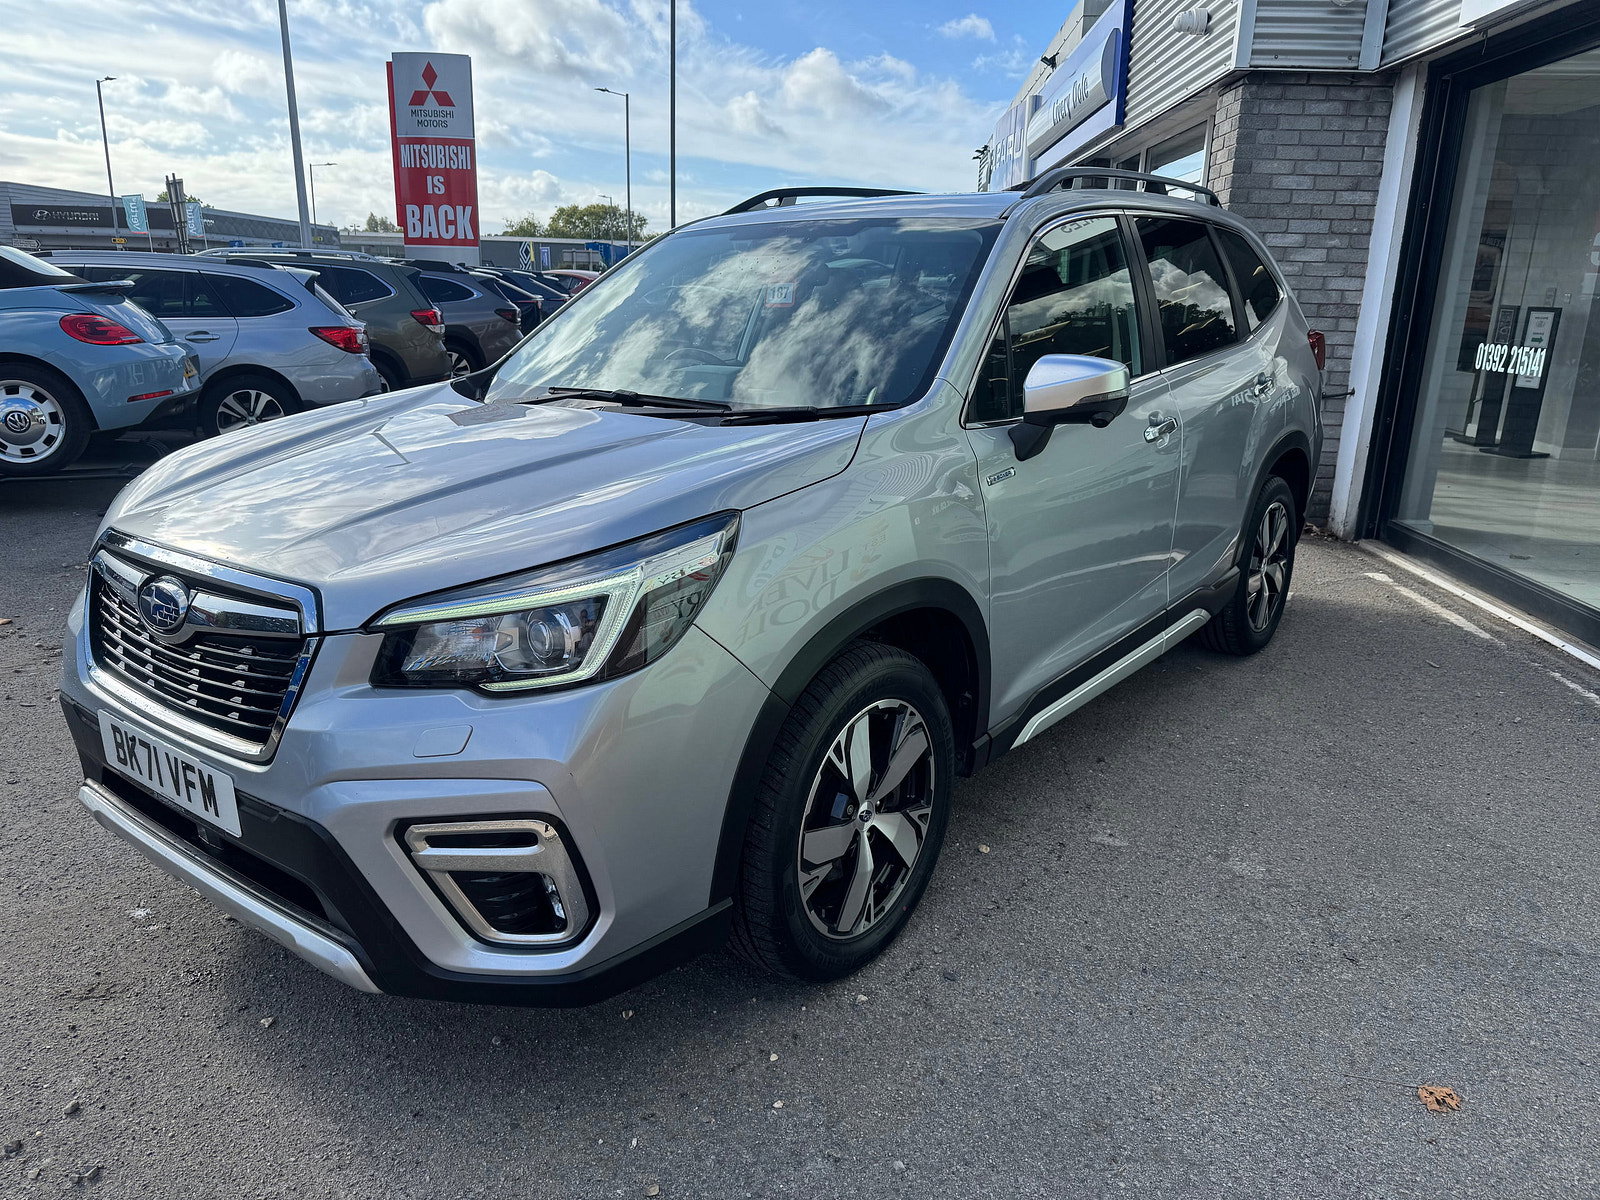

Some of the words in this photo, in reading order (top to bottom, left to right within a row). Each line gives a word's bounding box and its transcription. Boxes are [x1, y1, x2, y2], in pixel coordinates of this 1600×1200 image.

[1072, 72, 1089, 109] Dole
[410, 109, 455, 119] MITSUBISHI
[416, 119, 449, 129] MOTORS
[400, 144, 471, 170] MITSUBISHI
[426, 175, 446, 195] IS
[52, 211, 100, 221] HYUNDAI
[405, 204, 475, 240] BACK
[1474, 342, 1509, 373] 01392
[1507, 345, 1547, 378] 215141
[110, 723, 165, 788] BK71
[164, 751, 220, 819] VFM
